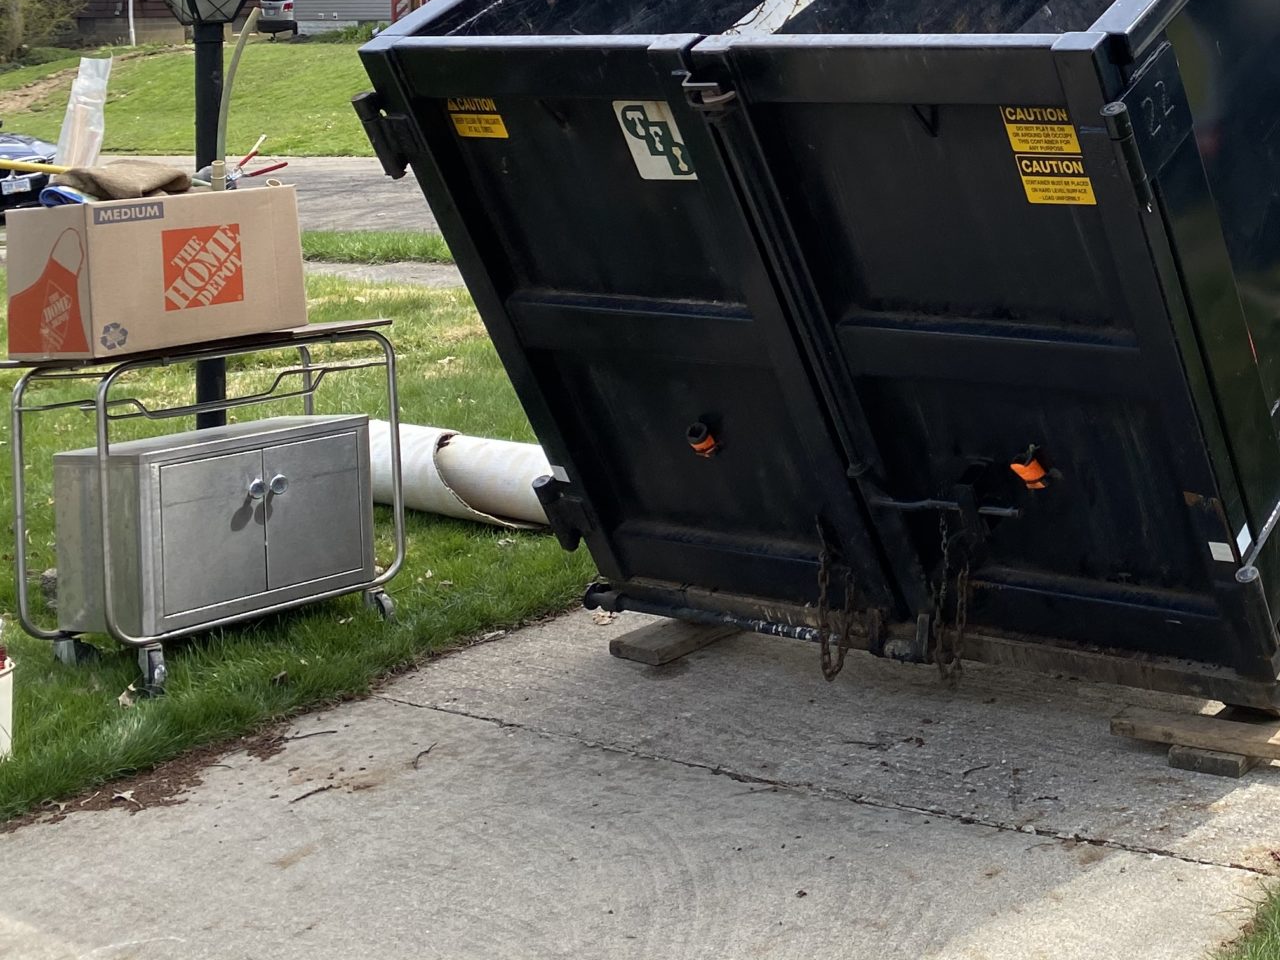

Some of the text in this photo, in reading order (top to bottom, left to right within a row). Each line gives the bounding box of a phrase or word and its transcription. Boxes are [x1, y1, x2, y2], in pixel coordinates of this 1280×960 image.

[455, 97, 497, 111] CAUTION
[1005, 107, 1069, 121] CAUTION
[1021, 160, 1084, 174] CAUTION
[99, 205, 160, 222] MEDIUM
[170, 235, 204, 268] THE
[165, 224, 241, 310] HOME
[195, 252, 242, 307] DEPOT
